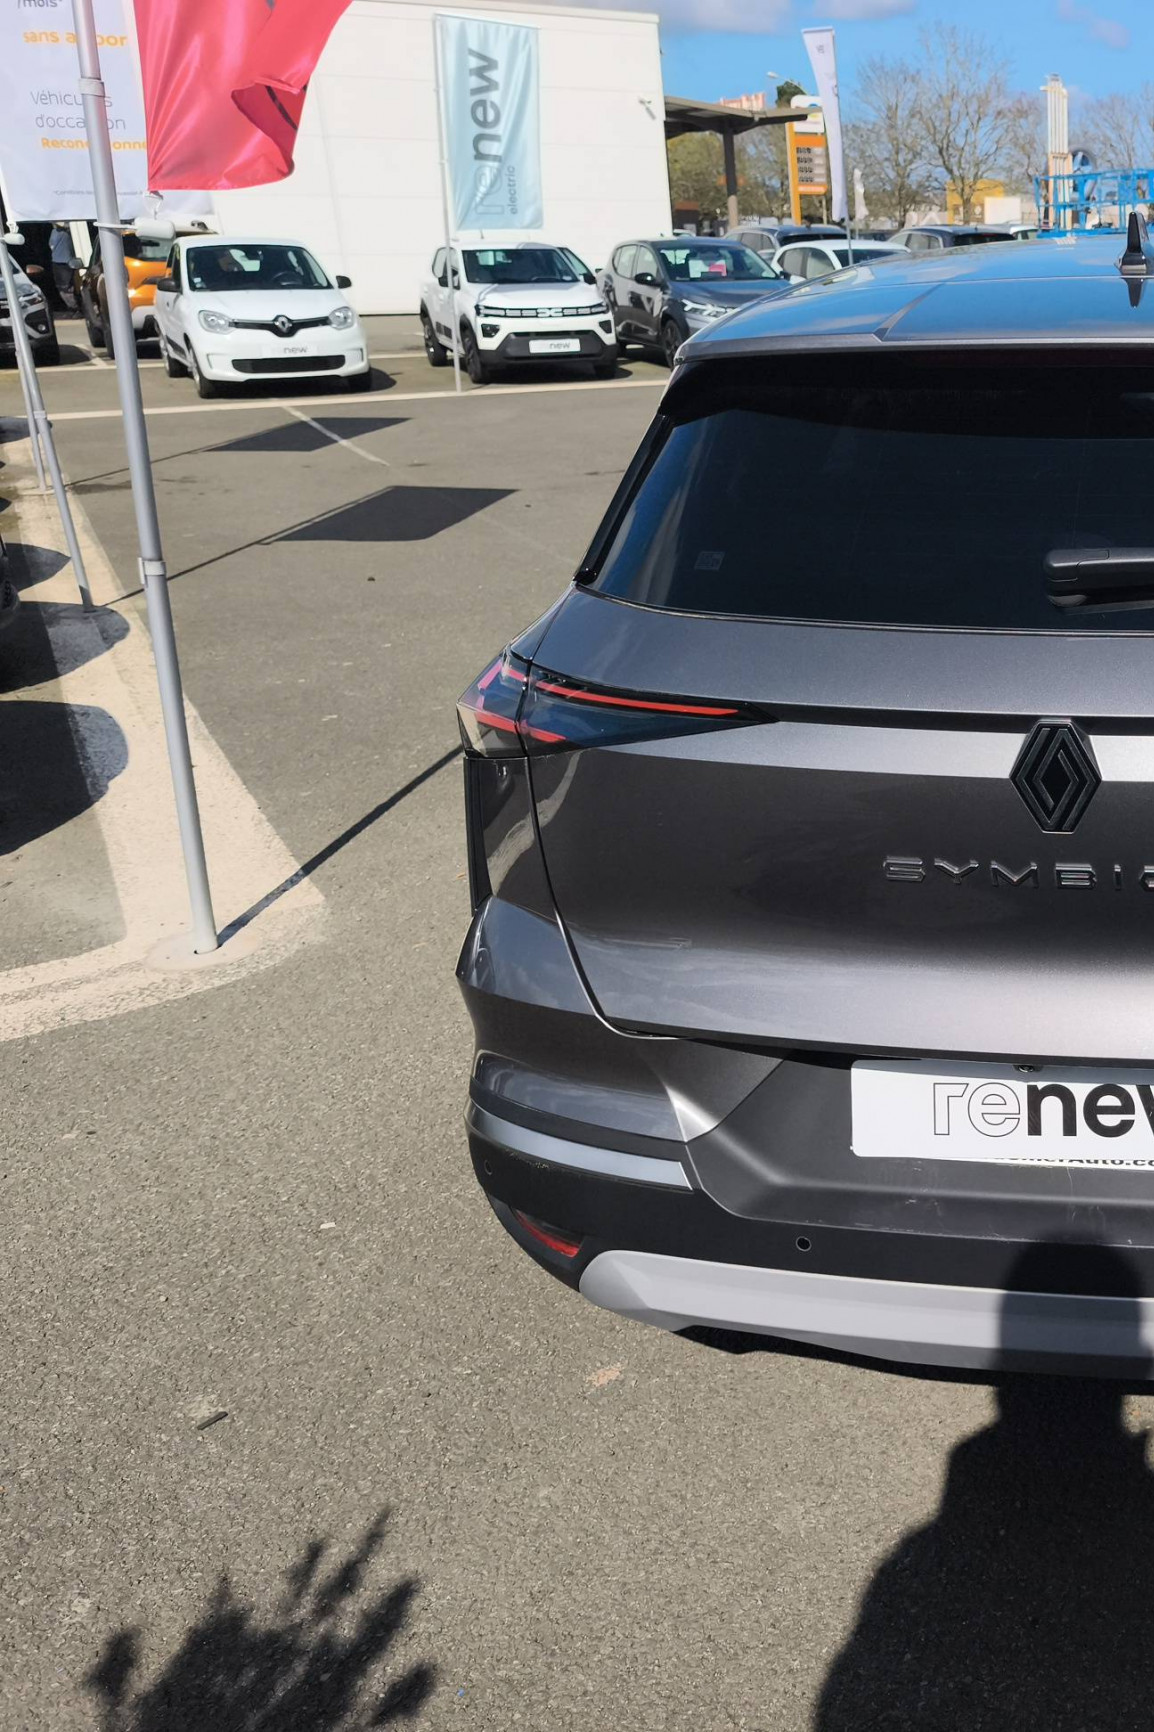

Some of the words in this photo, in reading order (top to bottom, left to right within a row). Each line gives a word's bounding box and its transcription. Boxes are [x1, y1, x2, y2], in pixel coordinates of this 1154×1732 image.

[23, 31, 60, 44] sans
[65, 32, 128, 47] apor
[30, 90, 113, 108] Véhicus
[35, 114, 126, 130] d'occaon
[467, 47, 505, 216] renew
[41, 137, 147, 151] Recononn
[504, 165, 518, 215] electric
